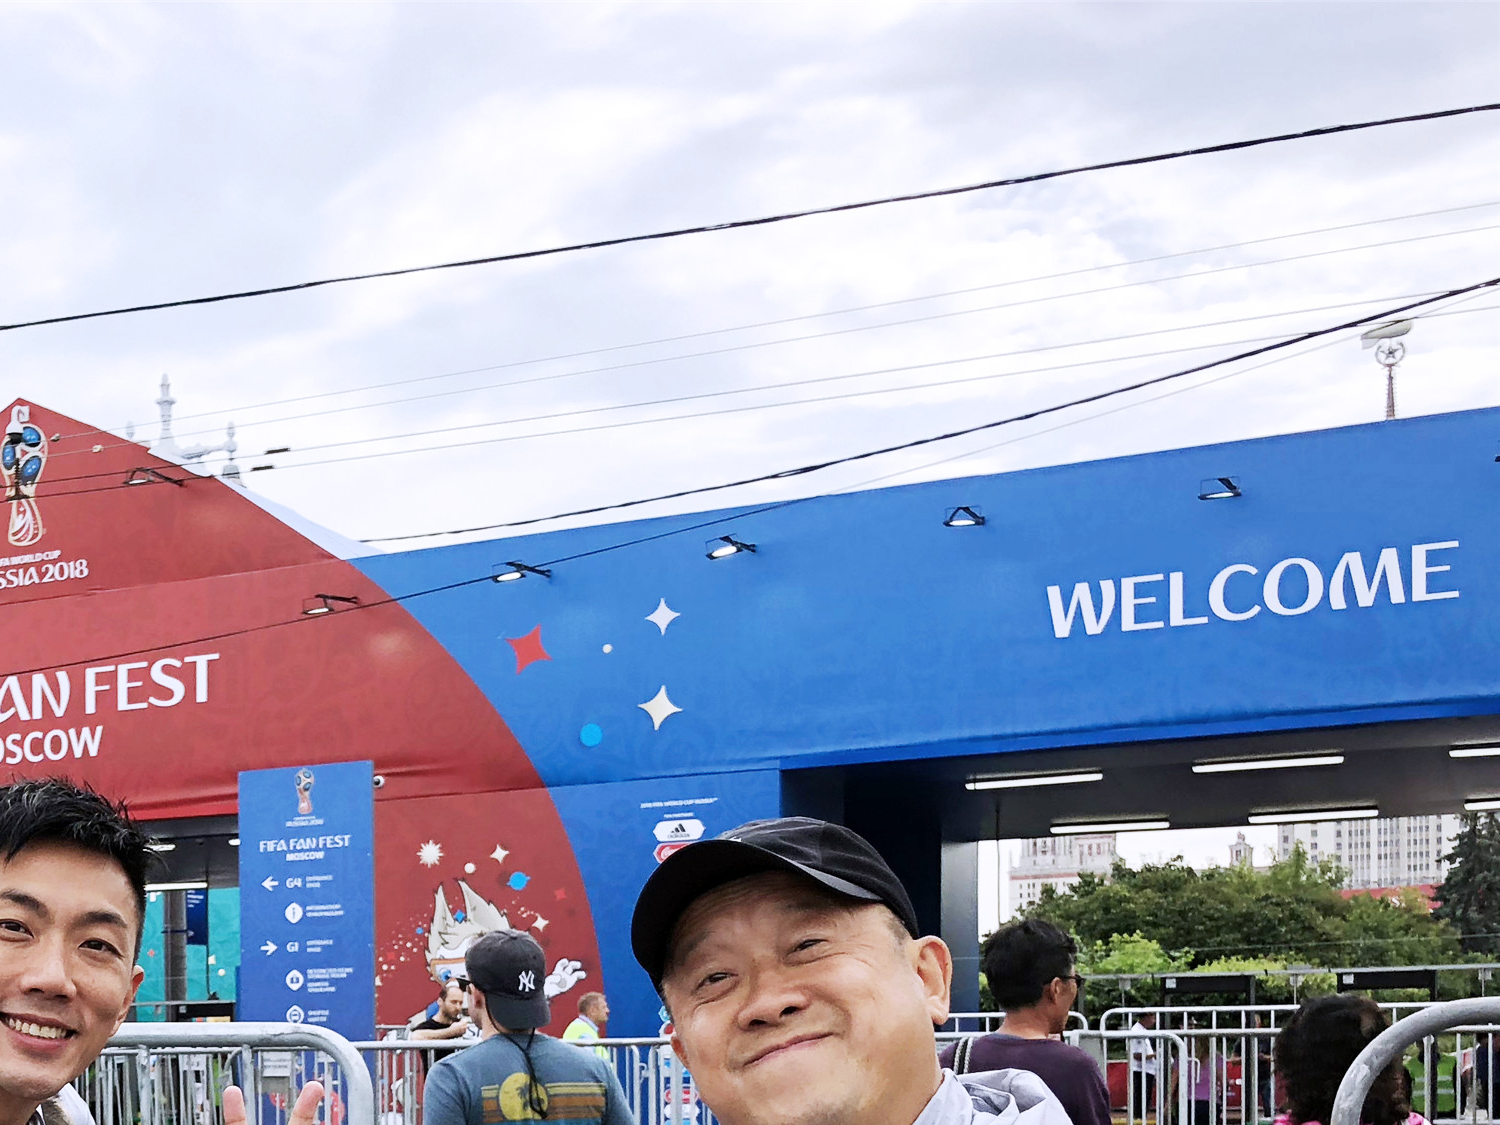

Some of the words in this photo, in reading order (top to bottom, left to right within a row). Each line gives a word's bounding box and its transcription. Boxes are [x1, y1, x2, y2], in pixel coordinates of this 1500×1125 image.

[41, 559, 89, 583] 2018
[1046, 540, 1460, 639] WELCOME
[85, 653, 220, 715] FEST
[260, 839, 287, 853] FIFA
[289, 837, 316, 851] FAN
[319, 834, 351, 849] FEST
[285, 851, 325, 862] MOSCOW
[285, 877, 303, 889] G4
[518, 970, 536, 992] NY
